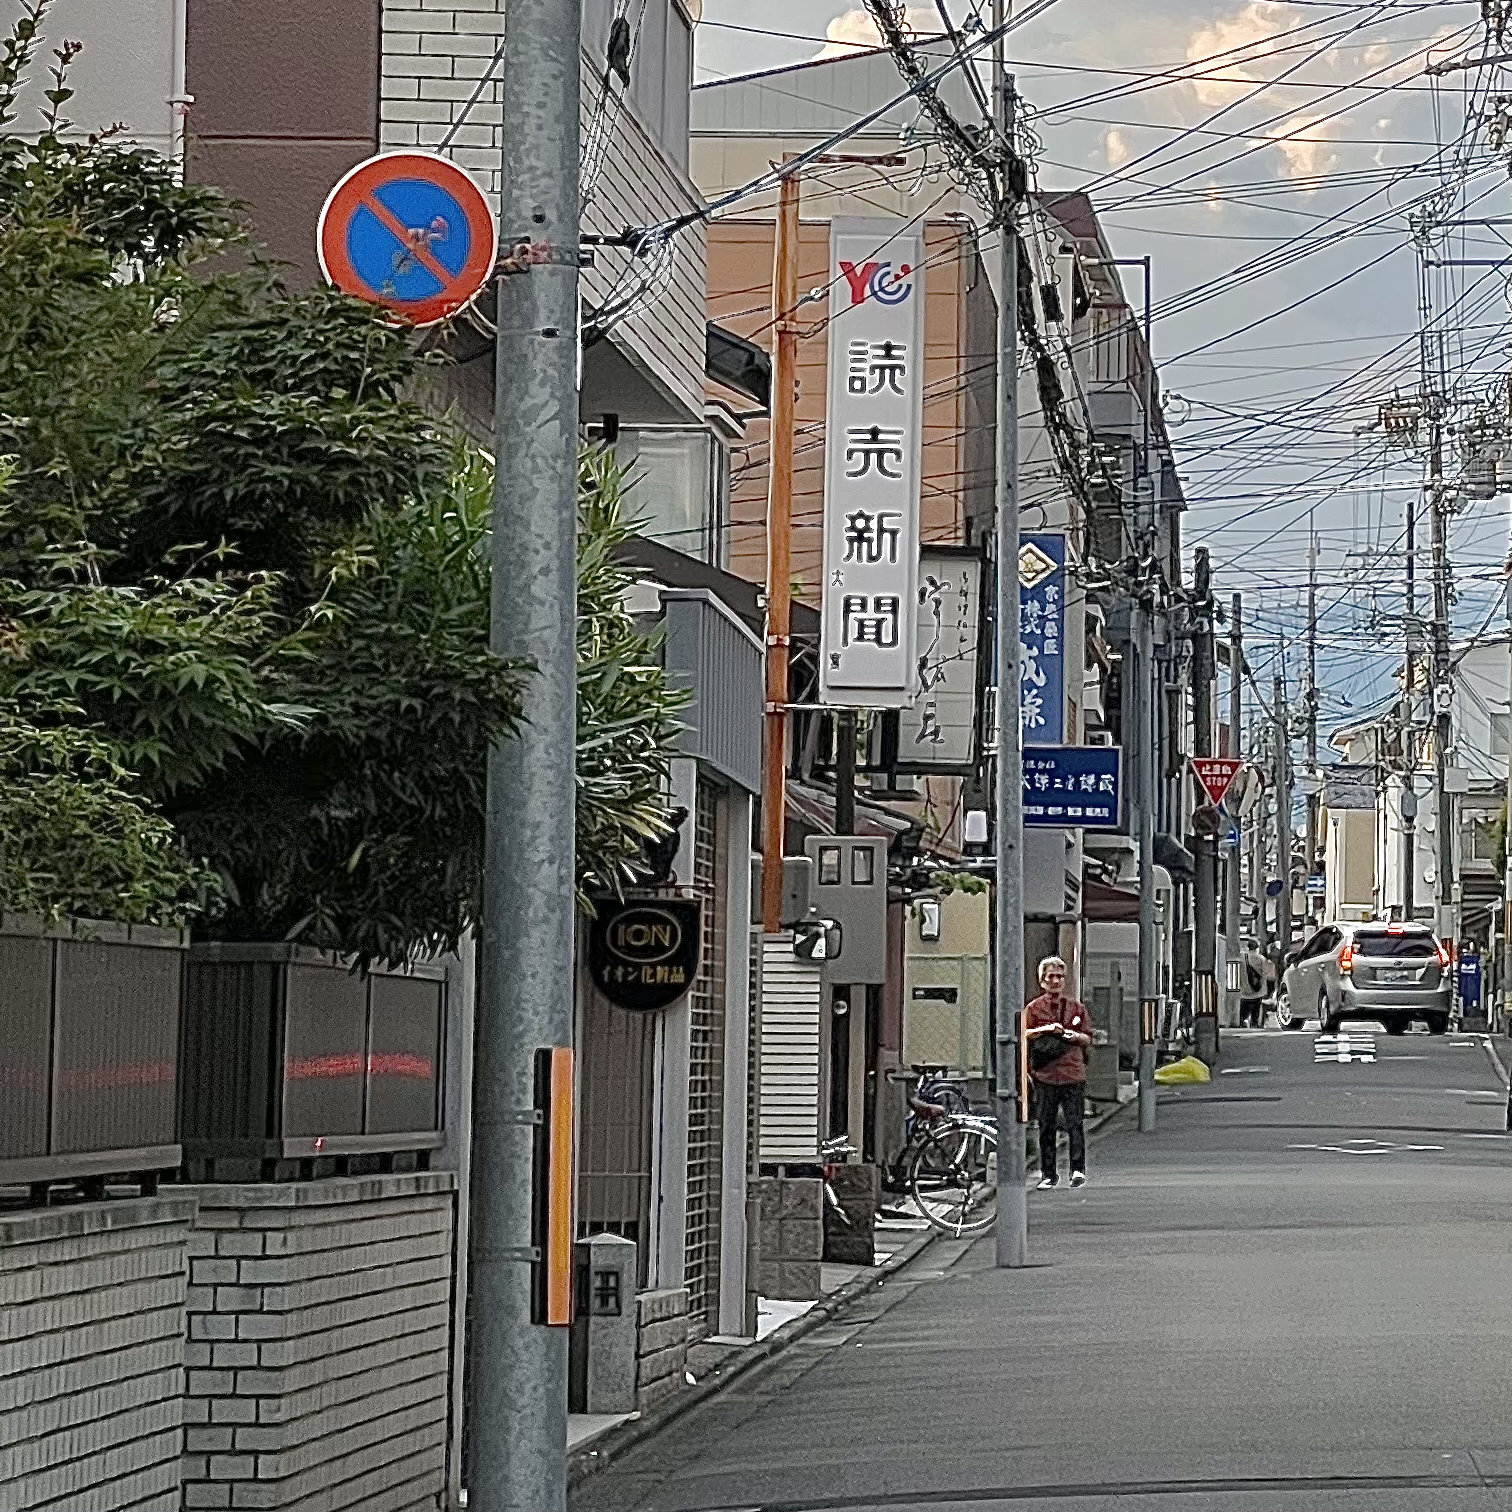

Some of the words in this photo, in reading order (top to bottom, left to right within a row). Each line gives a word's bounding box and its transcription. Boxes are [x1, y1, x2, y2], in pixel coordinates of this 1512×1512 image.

[840, 340, 908, 650] 読売新聞
[1205, 776, 1229, 787] STOP
[617, 923, 672, 947] ION
[602, 965, 686, 984] イオン化粧品
